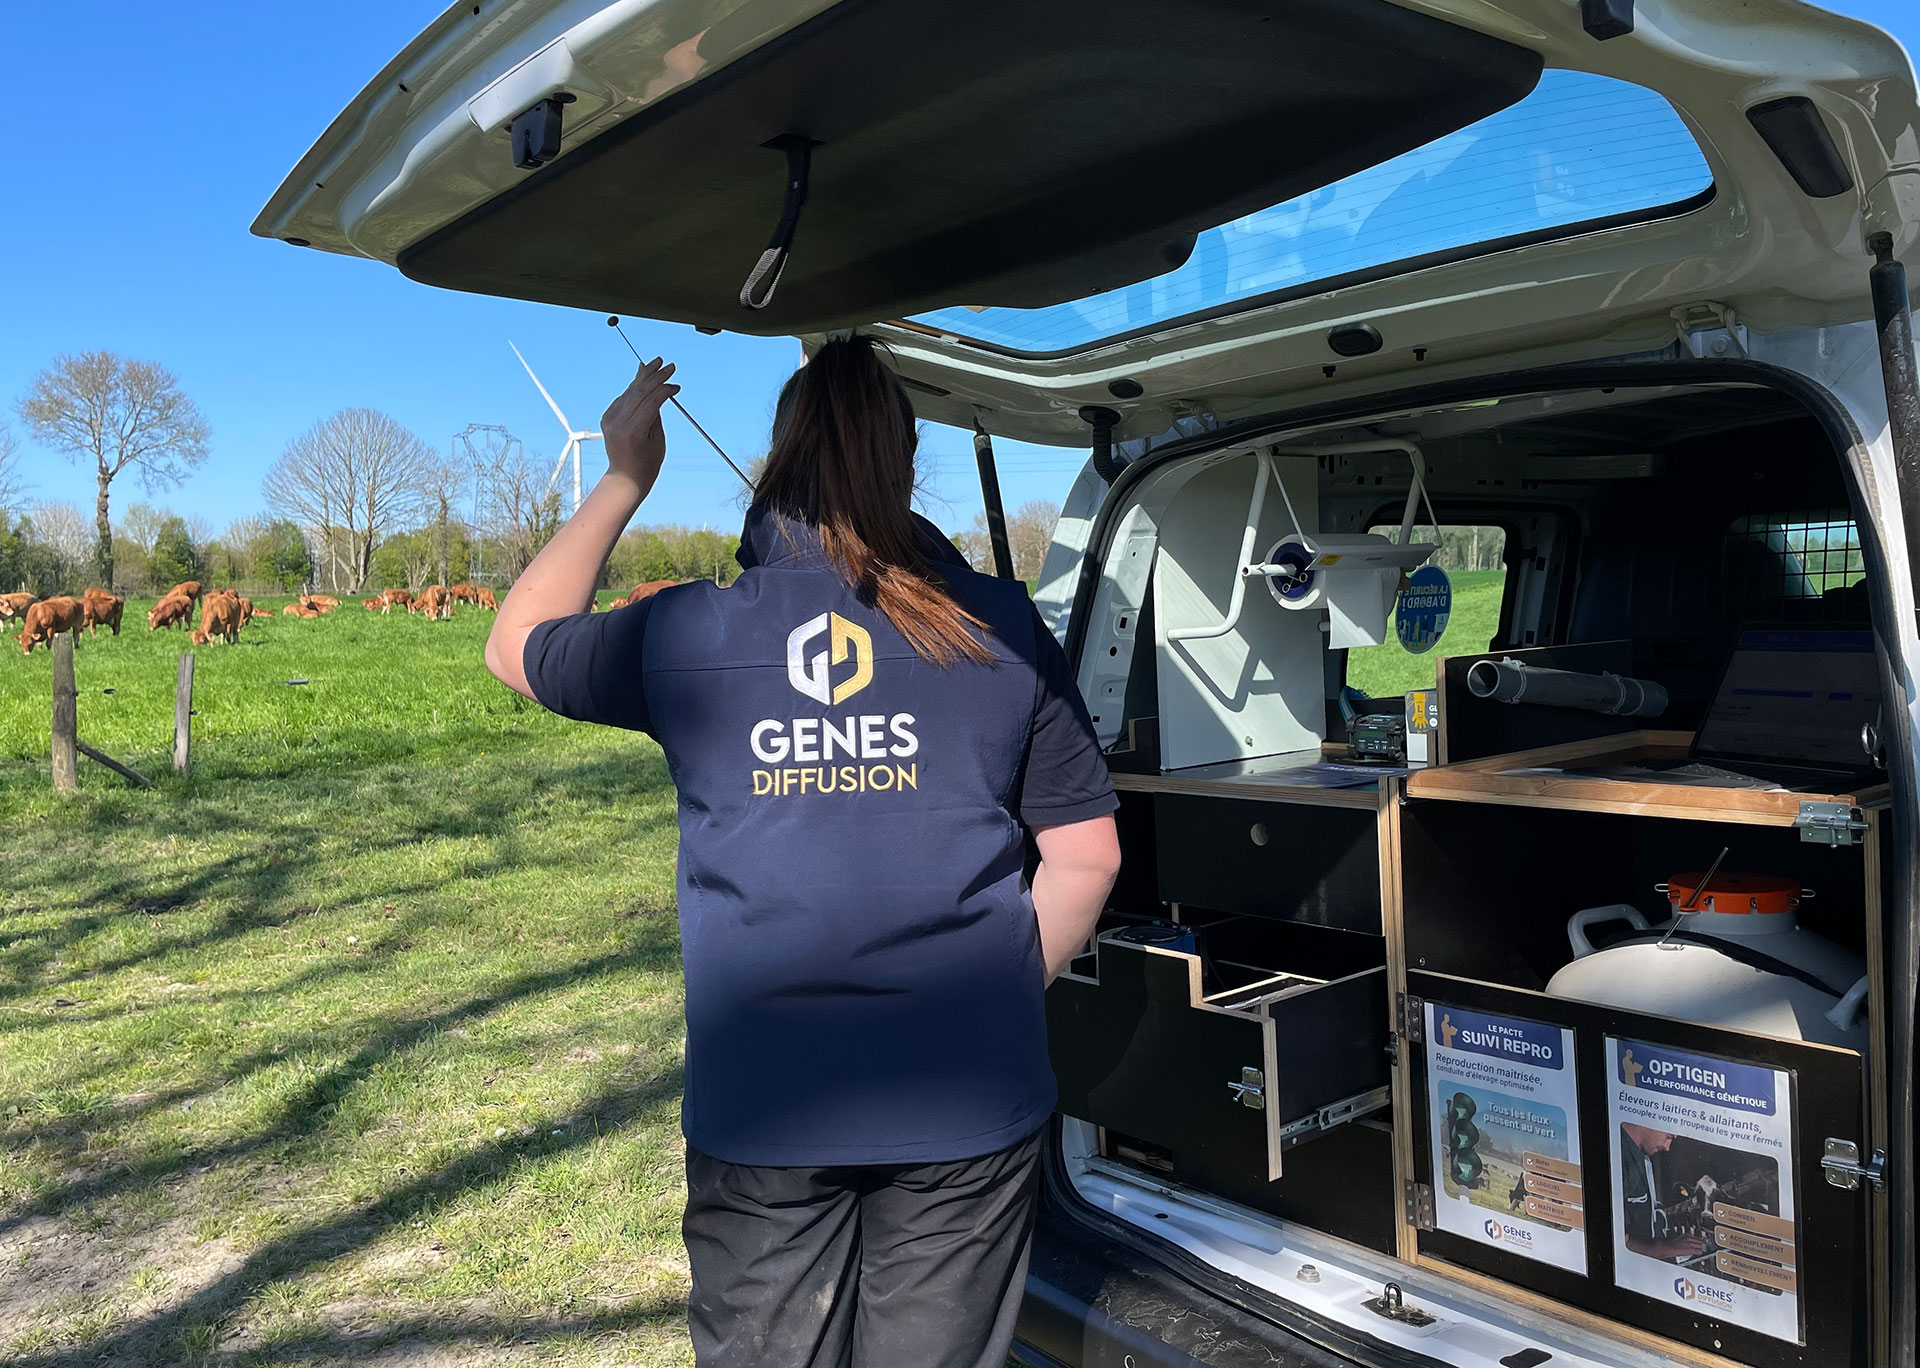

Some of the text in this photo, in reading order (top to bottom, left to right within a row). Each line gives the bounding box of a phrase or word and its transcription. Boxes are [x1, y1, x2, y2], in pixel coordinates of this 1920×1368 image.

[750, 712, 919, 764] GENES
[752, 763, 918, 796] DIFFUSION
[1461, 1030, 1553, 1060] SUIVI REPRO
[1488, 1024, 1524, 1038] LE PACTE
[1436, 1052, 1543, 1086] Reproduction maîtrisée,
[1436, 1064, 1535, 1092] conduite d'élevage optimisée
[1649, 1059, 1726, 1089] OPTIGEN
[1641, 1075, 1768, 1109] LA PERFORMANCE GÉNÉTIQUE
[1488, 1101, 1549, 1126] Tous les feux
[1618, 1089, 1762, 1134] Éleveurs laitiers & allaitants,
[1483, 1114, 1555, 1138] passent au vert
[1619, 1104, 1783, 1148] accouplez votre troupeau les yeux fermés
[1537, 1180, 1560, 1191] LOGICIEL
[1728, 1210, 1755, 1221] CONSEIL
[1503, 1225, 1532, 1241] GENES
[1730, 1234, 1784, 1254] ACCOUPLEMENT
[1697, 1284, 1733, 1303] GENES
